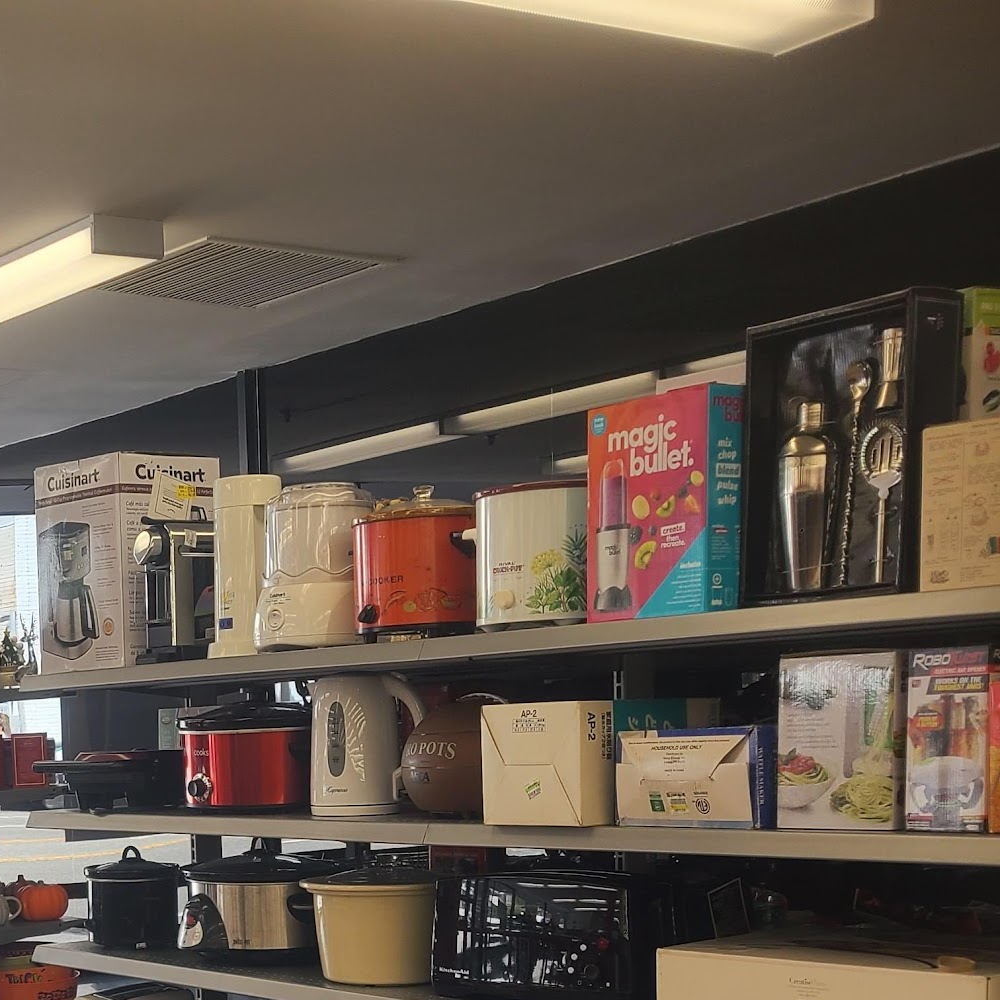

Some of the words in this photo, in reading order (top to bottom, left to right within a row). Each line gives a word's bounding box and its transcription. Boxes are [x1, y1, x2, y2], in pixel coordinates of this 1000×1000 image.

[608, 414, 677, 453] magic
[718, 437, 732, 447] mix
[718, 450, 737, 460] chop
[135, 464, 206, 483] Cuinart
[718, 465, 739, 476] blend
[47, 468, 100, 492] Cuisinart
[717, 480, 739, 491] pulse
[718, 494, 737, 506] whip
[520, 709, 537, 718] AP-2
[587, 712, 596, 741] AP-2
[194, 748, 209, 757] cooks
[419, 741, 457, 760] POTS
[439, 966, 470, 975] KitchenAid
